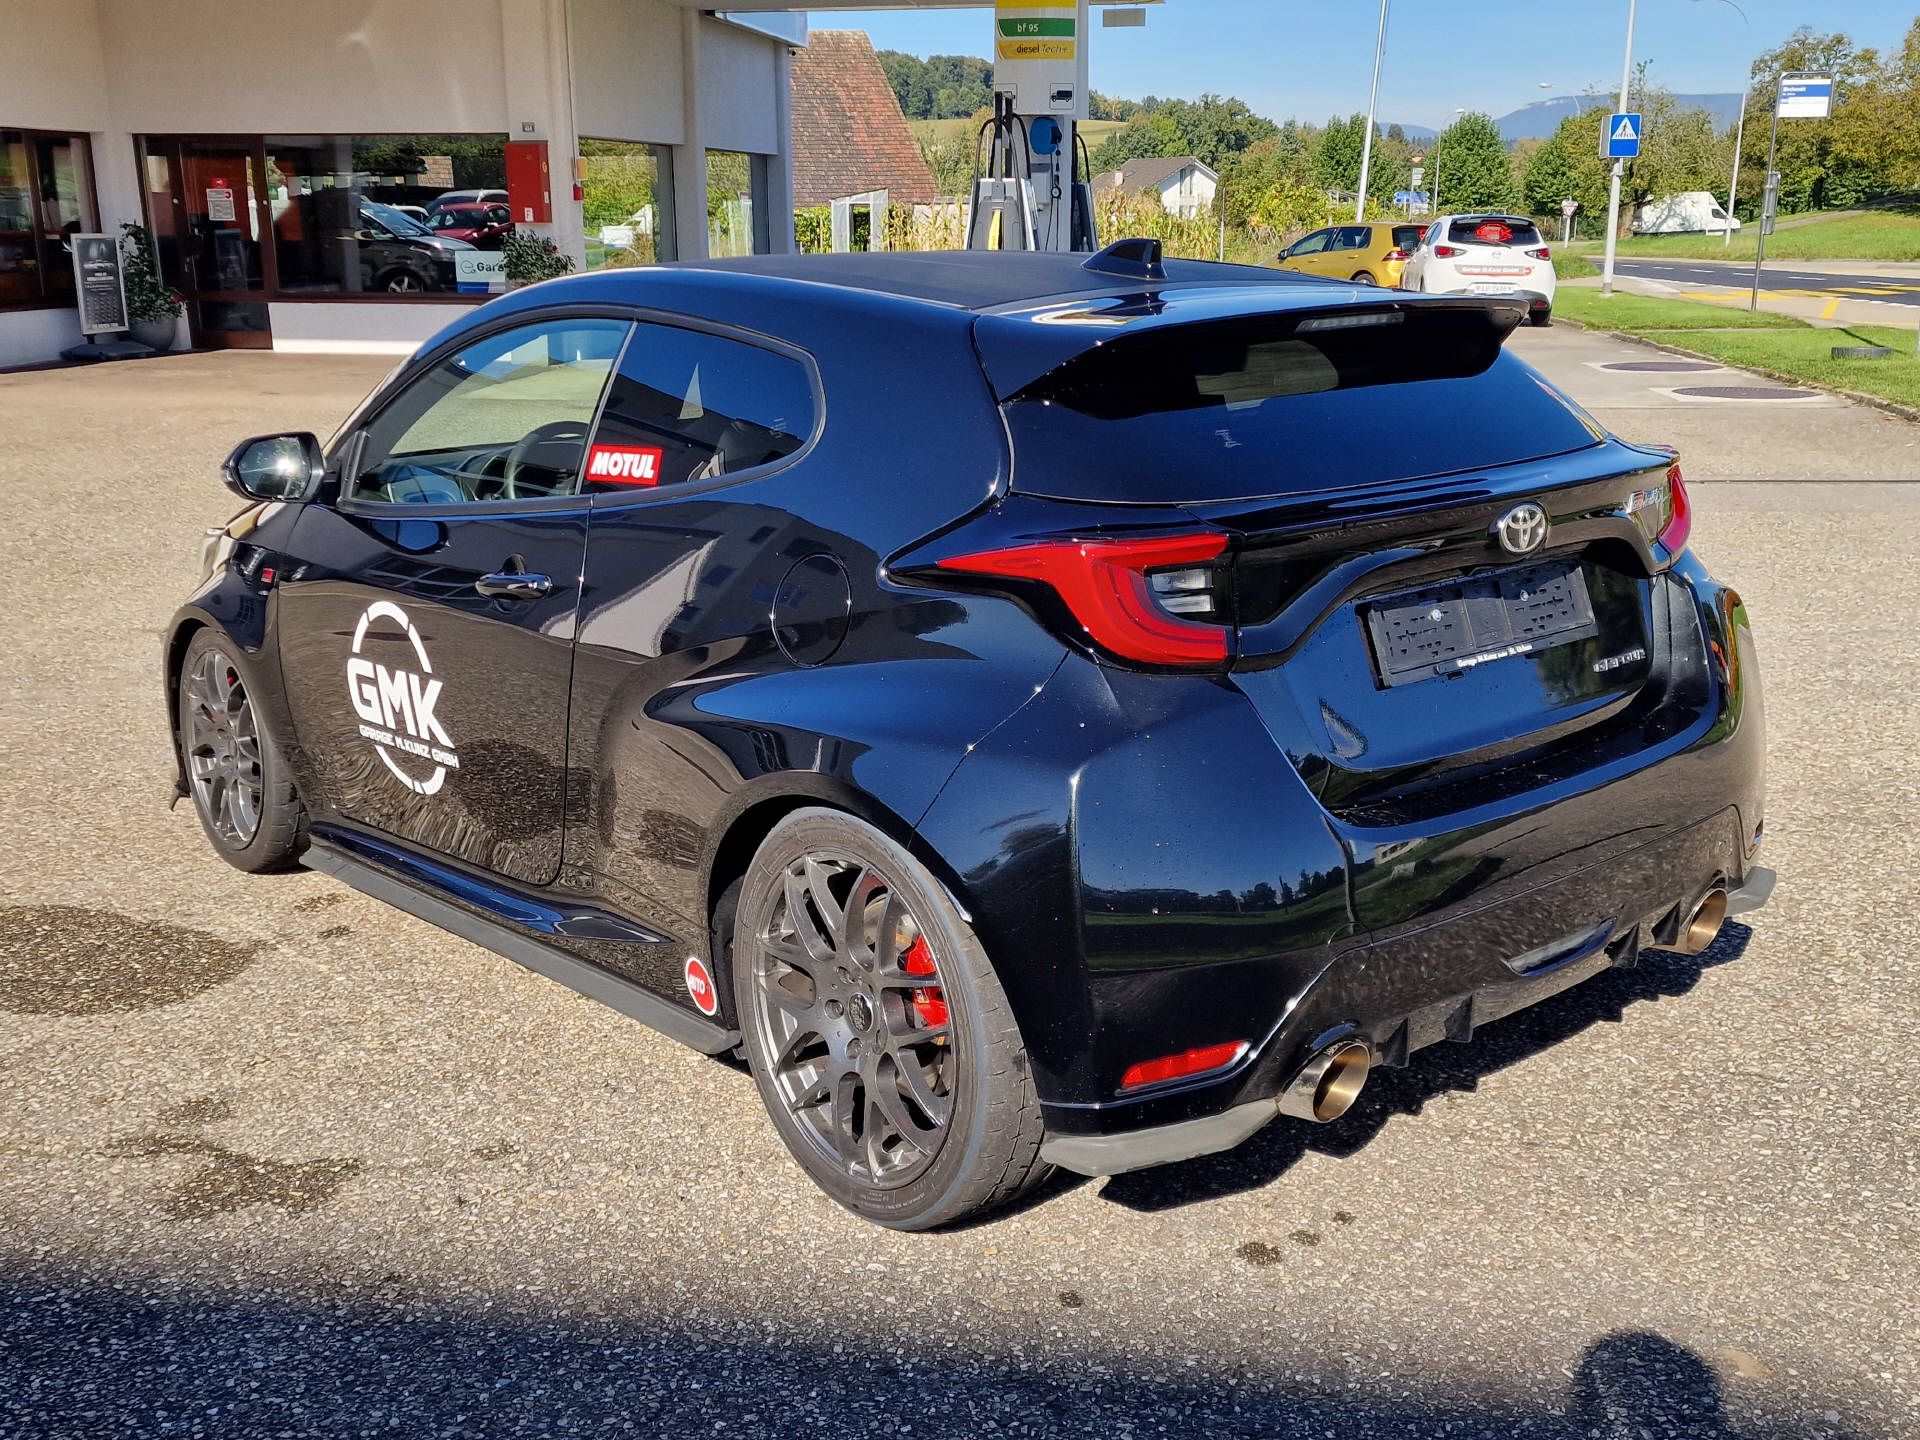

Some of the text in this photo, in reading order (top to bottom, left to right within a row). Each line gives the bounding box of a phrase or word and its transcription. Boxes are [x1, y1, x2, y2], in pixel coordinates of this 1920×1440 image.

[1017, 23, 1038, 32] bf 95
[1016, 43, 1040, 54] diesel
[477, 262, 504, 272] Gara
[590, 451, 655, 478] MOTUL
[347, 658, 455, 749] GMK
